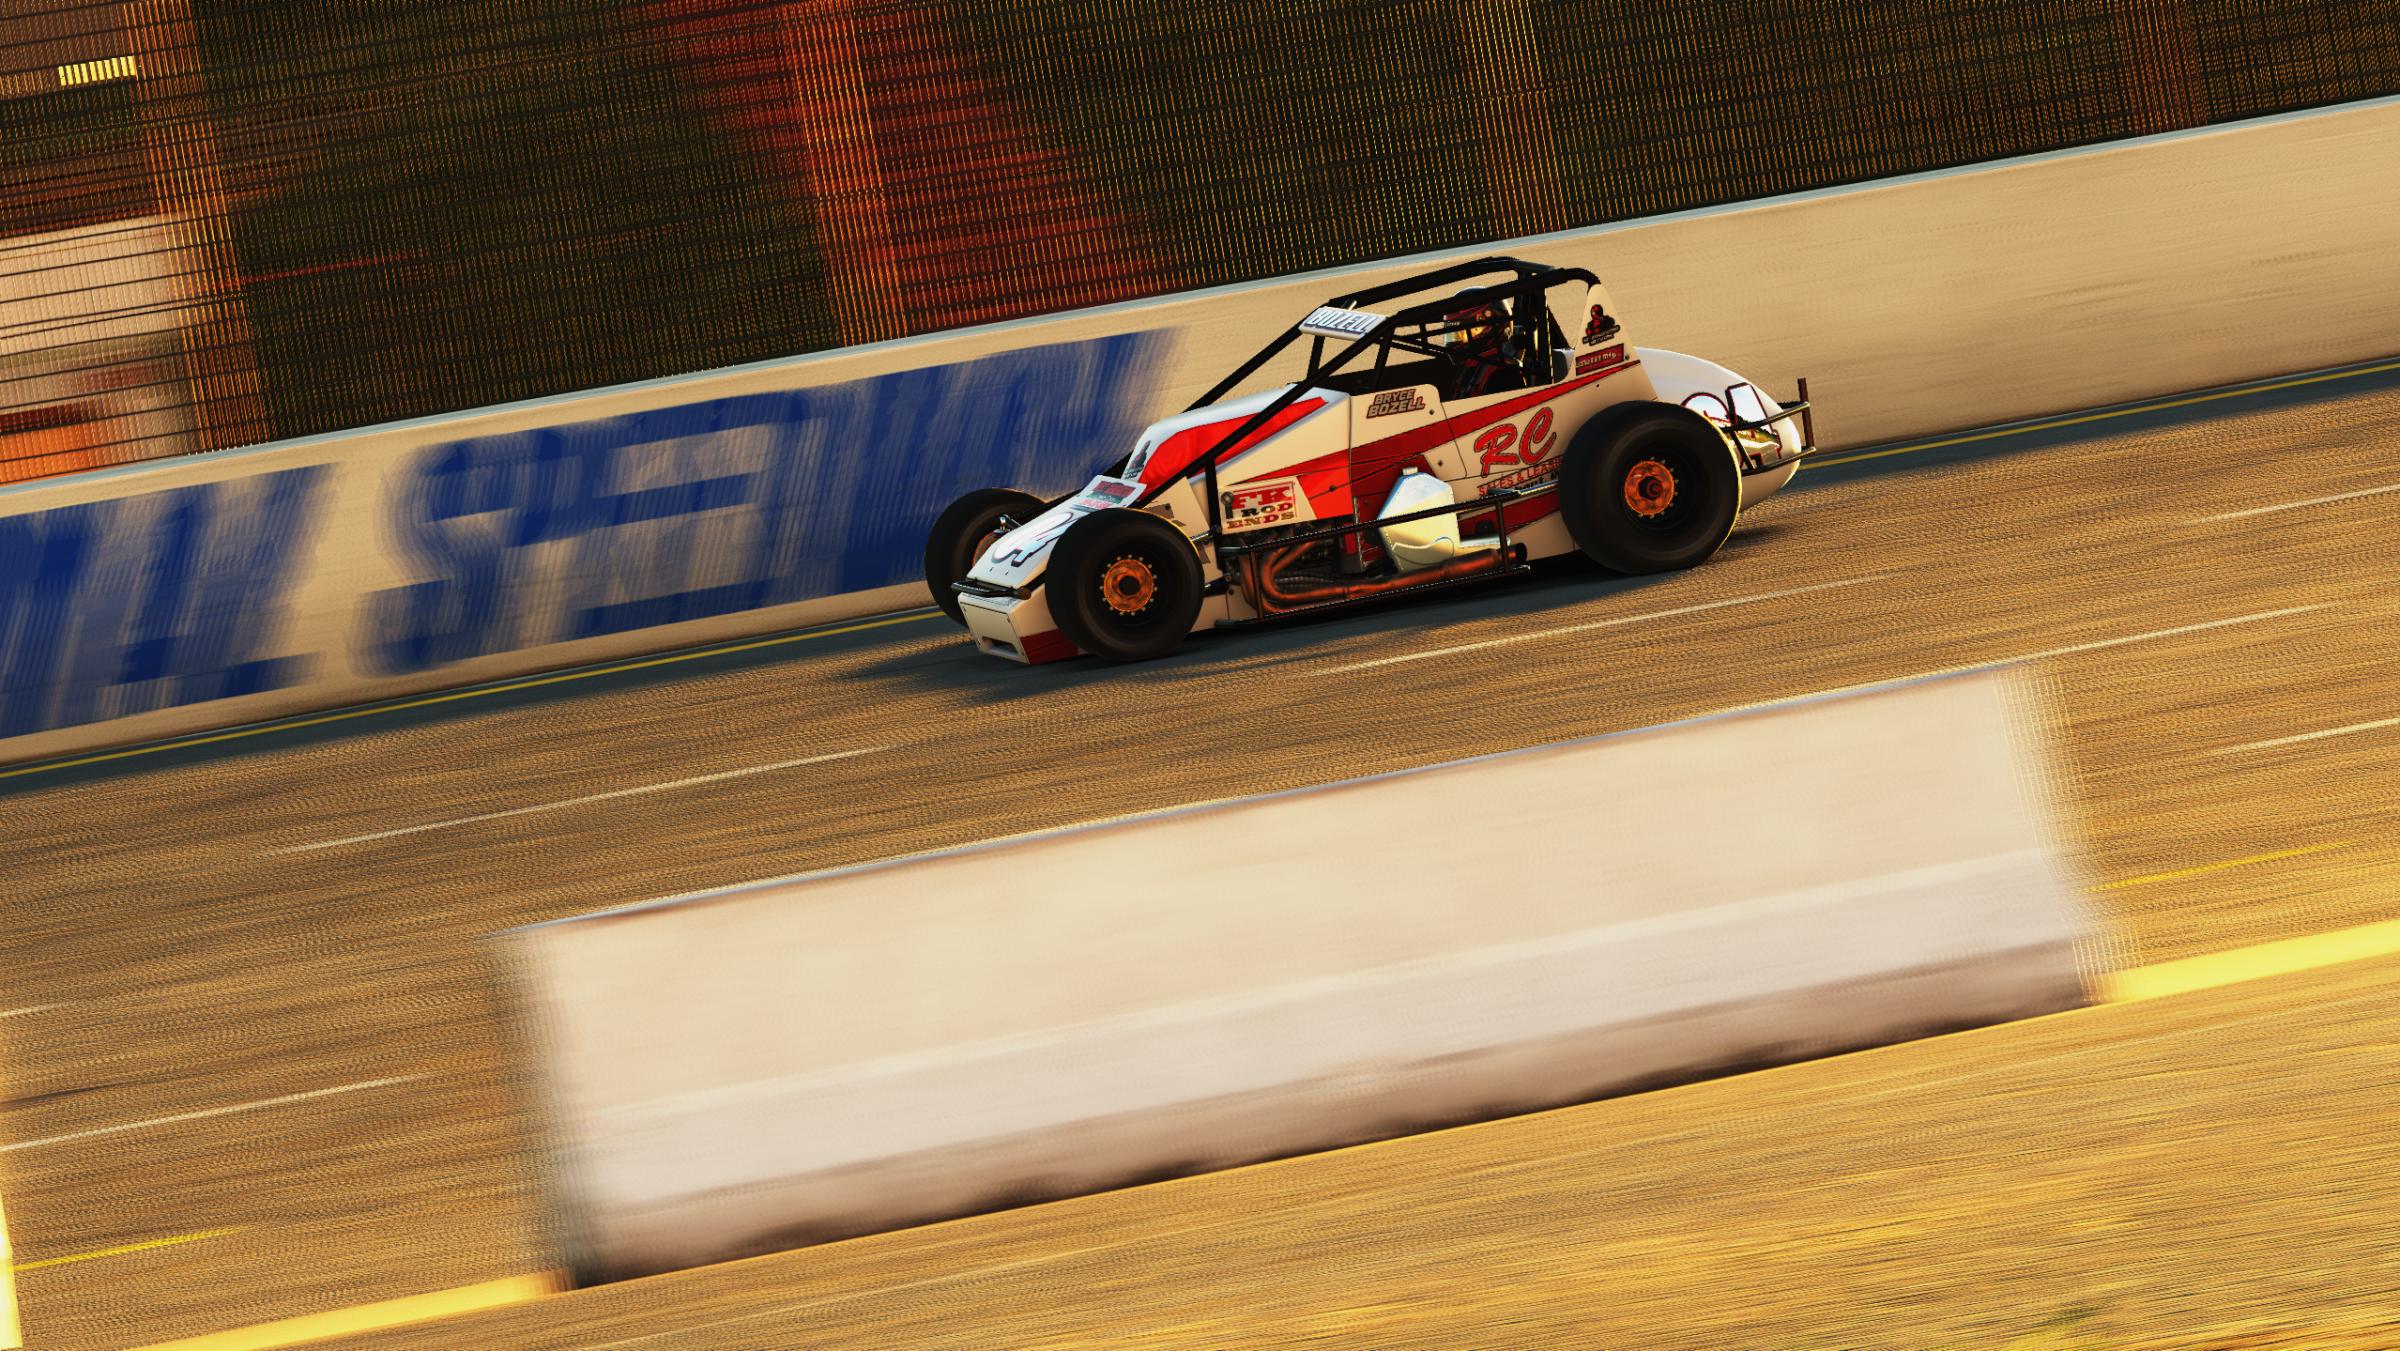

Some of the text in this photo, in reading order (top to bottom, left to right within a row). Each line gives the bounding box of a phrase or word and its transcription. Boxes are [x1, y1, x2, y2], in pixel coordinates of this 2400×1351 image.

[1303, 308, 1374, 334] BOZELL
[1365, 396, 1426, 419] BOZELL
[1373, 388, 1416, 405] BRYCE
[1473, 406, 1557, 478] RC
[1231, 485, 1292, 509] FK
[1226, 511, 1295, 529] ENDS
[1241, 502, 1294, 517] ROD
